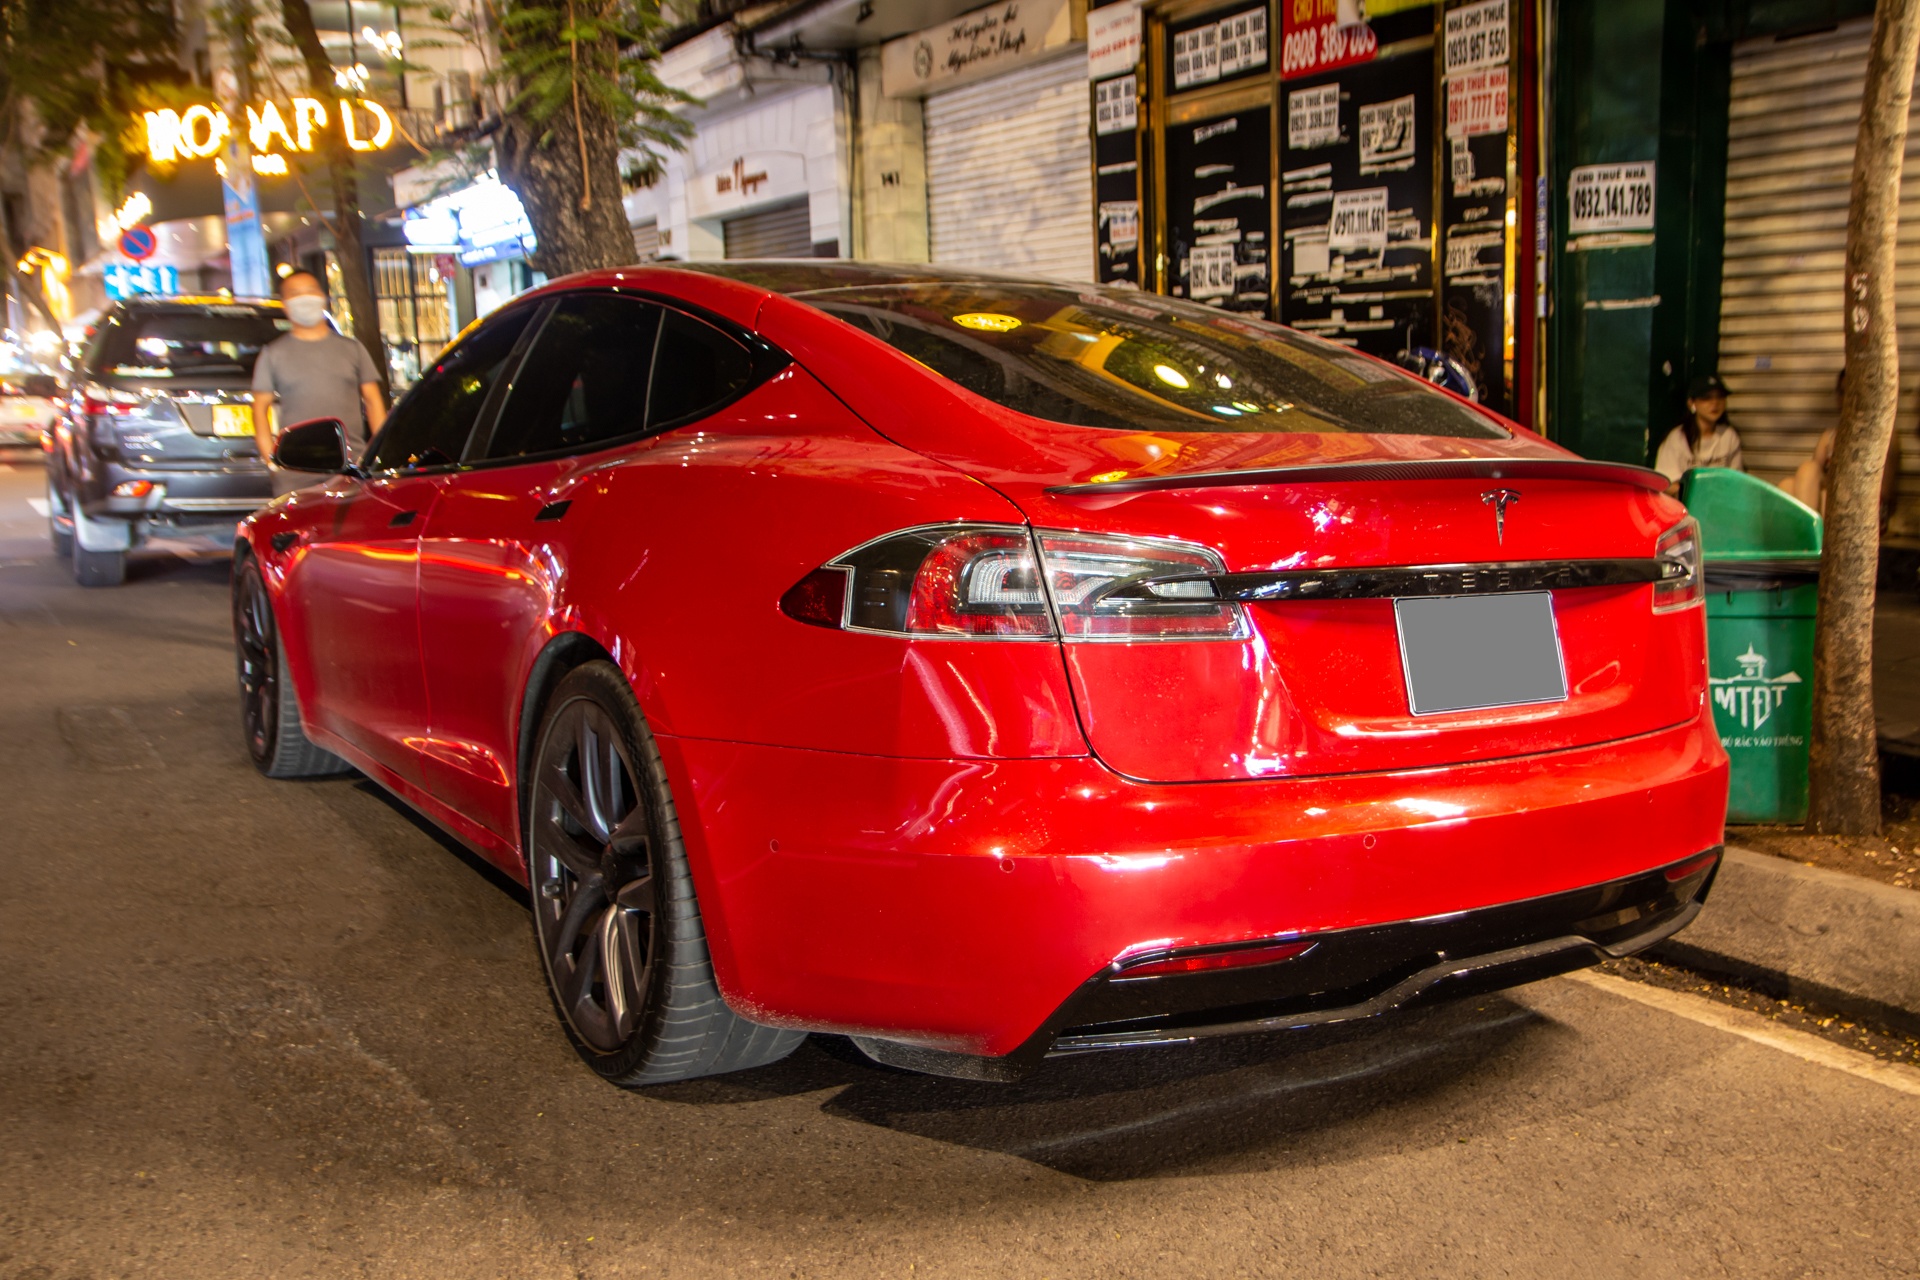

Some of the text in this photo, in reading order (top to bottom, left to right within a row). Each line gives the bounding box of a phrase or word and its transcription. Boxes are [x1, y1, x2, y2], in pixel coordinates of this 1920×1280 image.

[1465, 10, 1482, 29] CHO
[1282, 26, 1318, 74] 0908
[1448, 26, 1507, 68] 0933 957 550
[1450, 78, 1465, 96] CHO
[1449, 89, 1507, 124] 0911 7777 69
[1574, 182, 1651, 219] 0932.141.789
[1334, 205, 1386, 236] 0917.111.661
